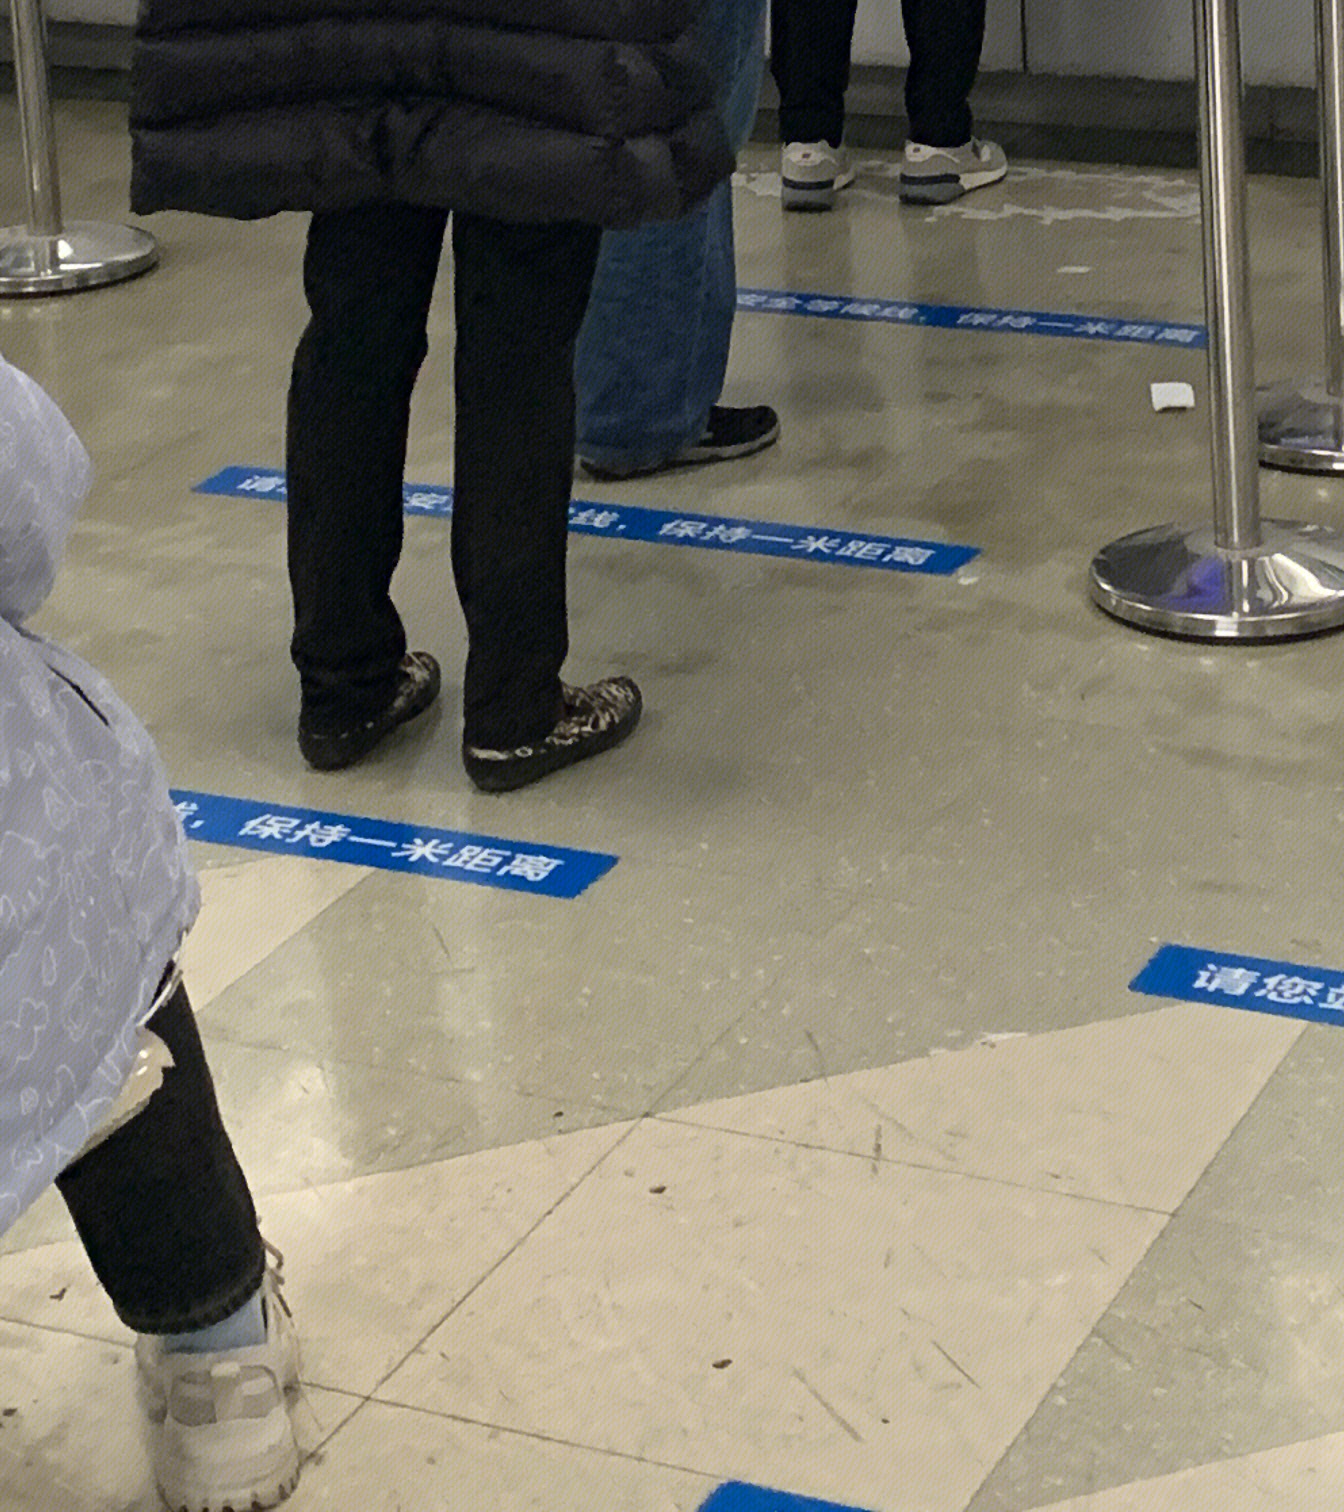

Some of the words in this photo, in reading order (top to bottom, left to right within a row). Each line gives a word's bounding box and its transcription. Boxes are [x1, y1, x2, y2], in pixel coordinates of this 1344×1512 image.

[657, 517, 936, 566] 保持一米距离
[236, 813, 566, 883] 保持一米距离
